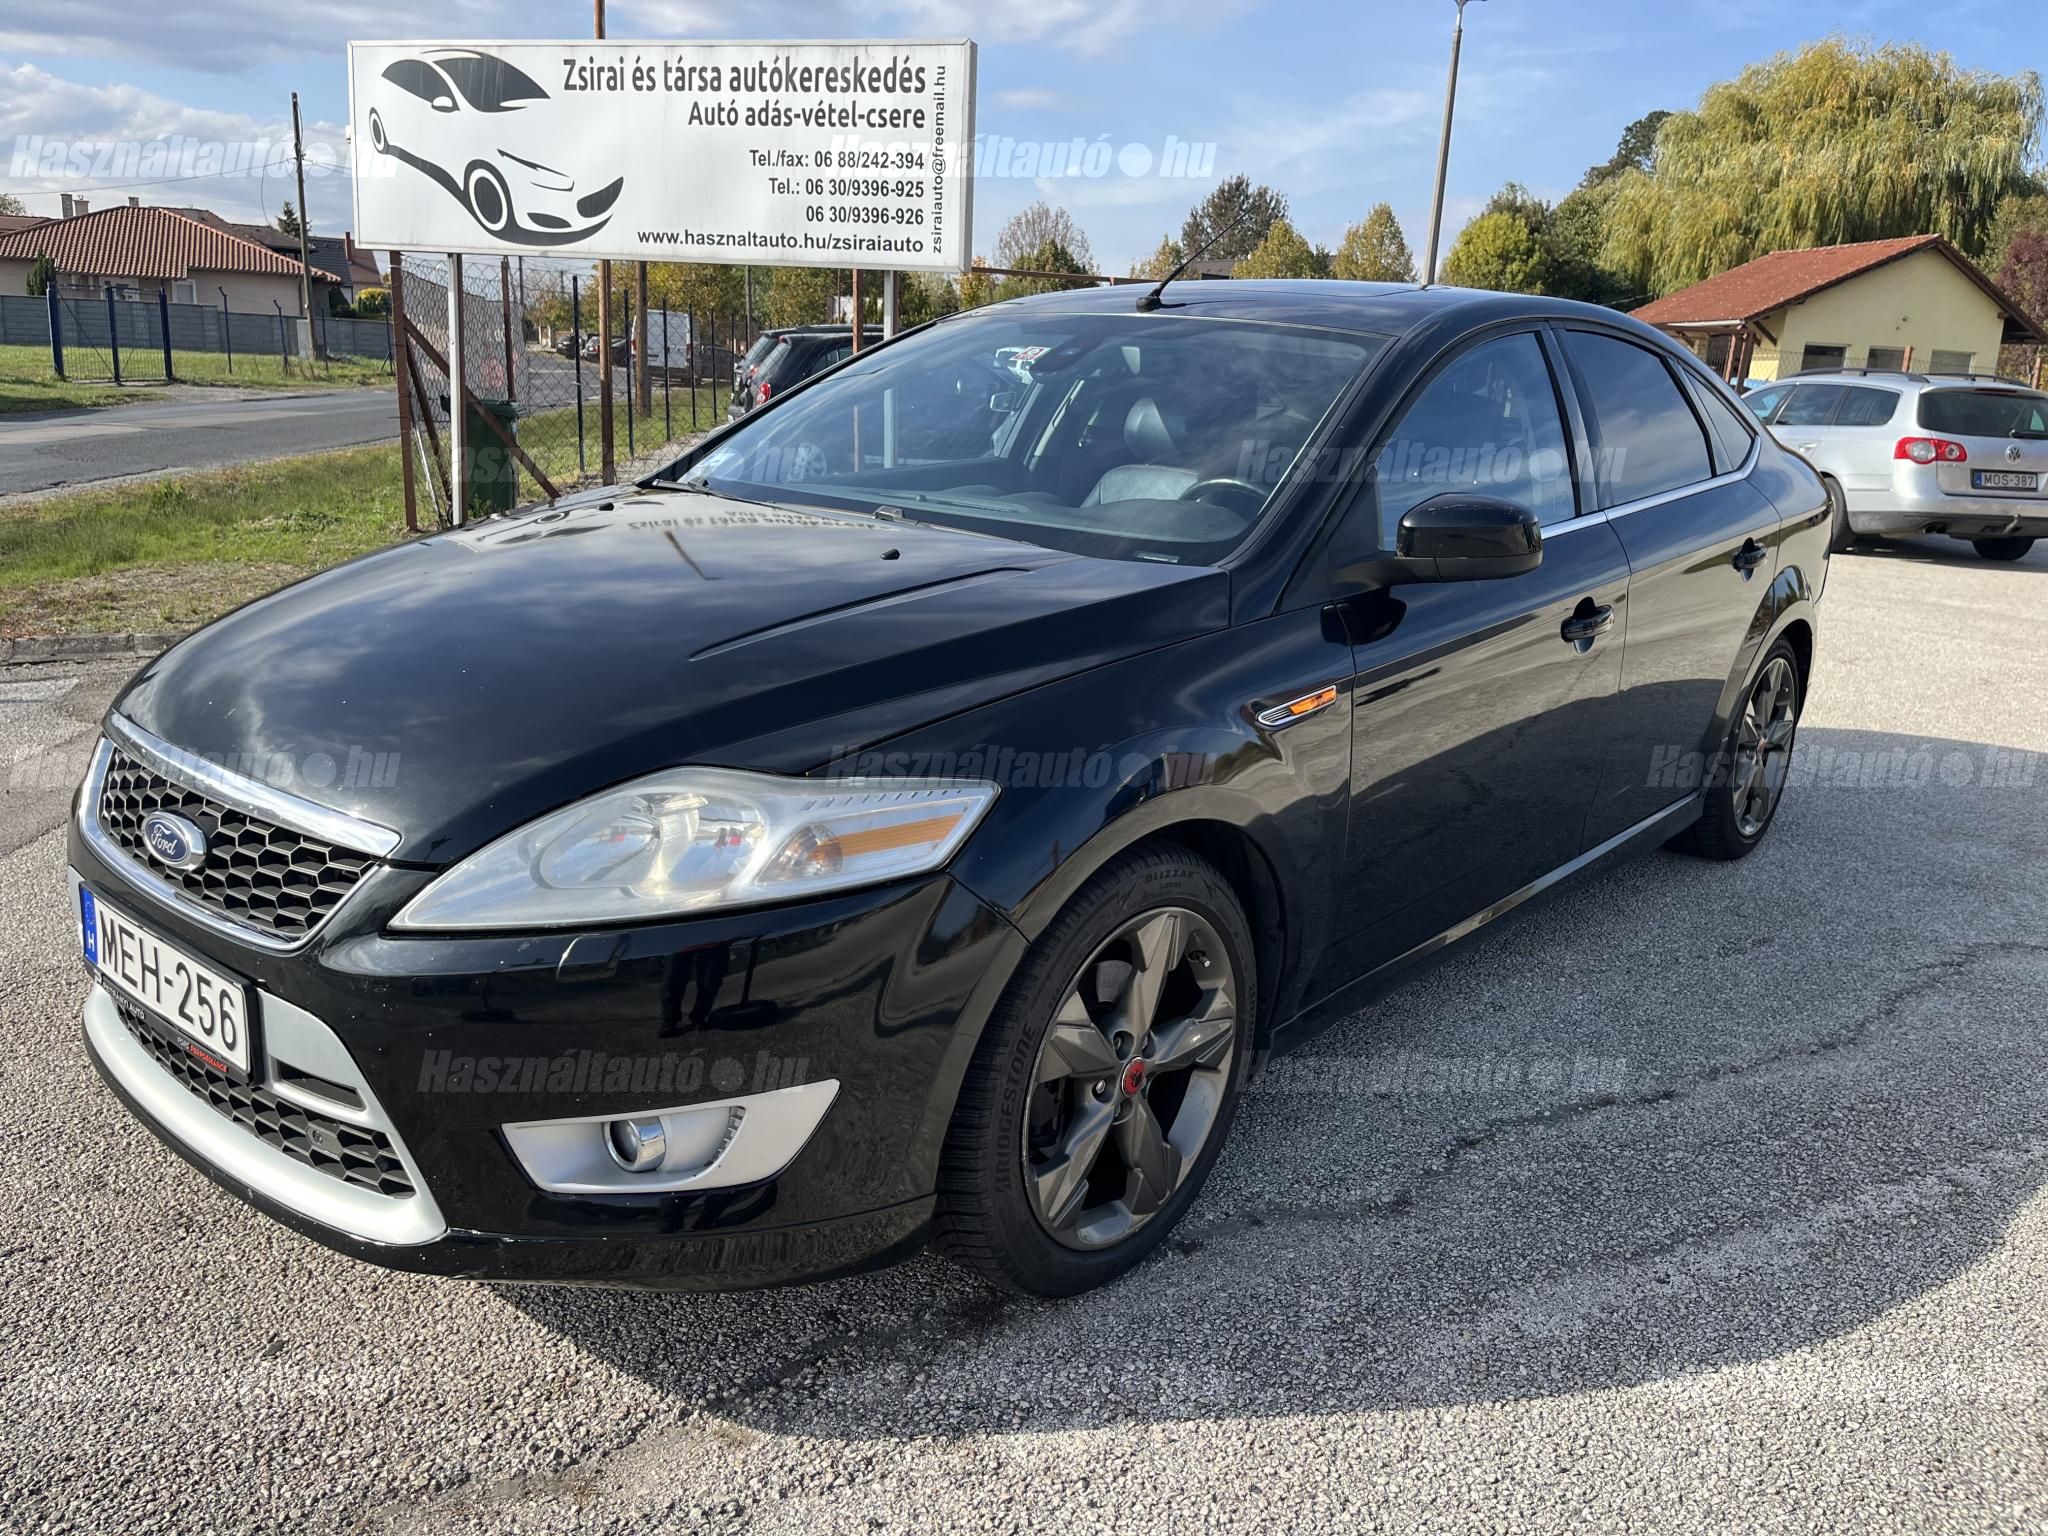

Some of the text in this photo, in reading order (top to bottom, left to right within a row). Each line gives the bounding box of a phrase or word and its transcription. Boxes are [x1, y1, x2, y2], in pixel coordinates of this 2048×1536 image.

[563, 54, 926, 93] Zsirai és társa autókereskedés
[688, 98, 925, 128] Autó adás-vétel-csere
[750, 150, 924, 169] Tel./fax: 06 88/242-394
[932, 65, 946, 254] zsiraiauto@freemail.hu
[769, 178, 924, 197] Tel.: 06 30/9396-925
[806, 206, 924, 225] 06 30/9396-926
[637, 229, 924, 253] www.hasznaltauto.hu/zsiraiauto
[1984, 473, 2034, 487] MOS-387
[151, 824, 177, 855] Ford
[100, 909, 237, 1051] MEH-256
